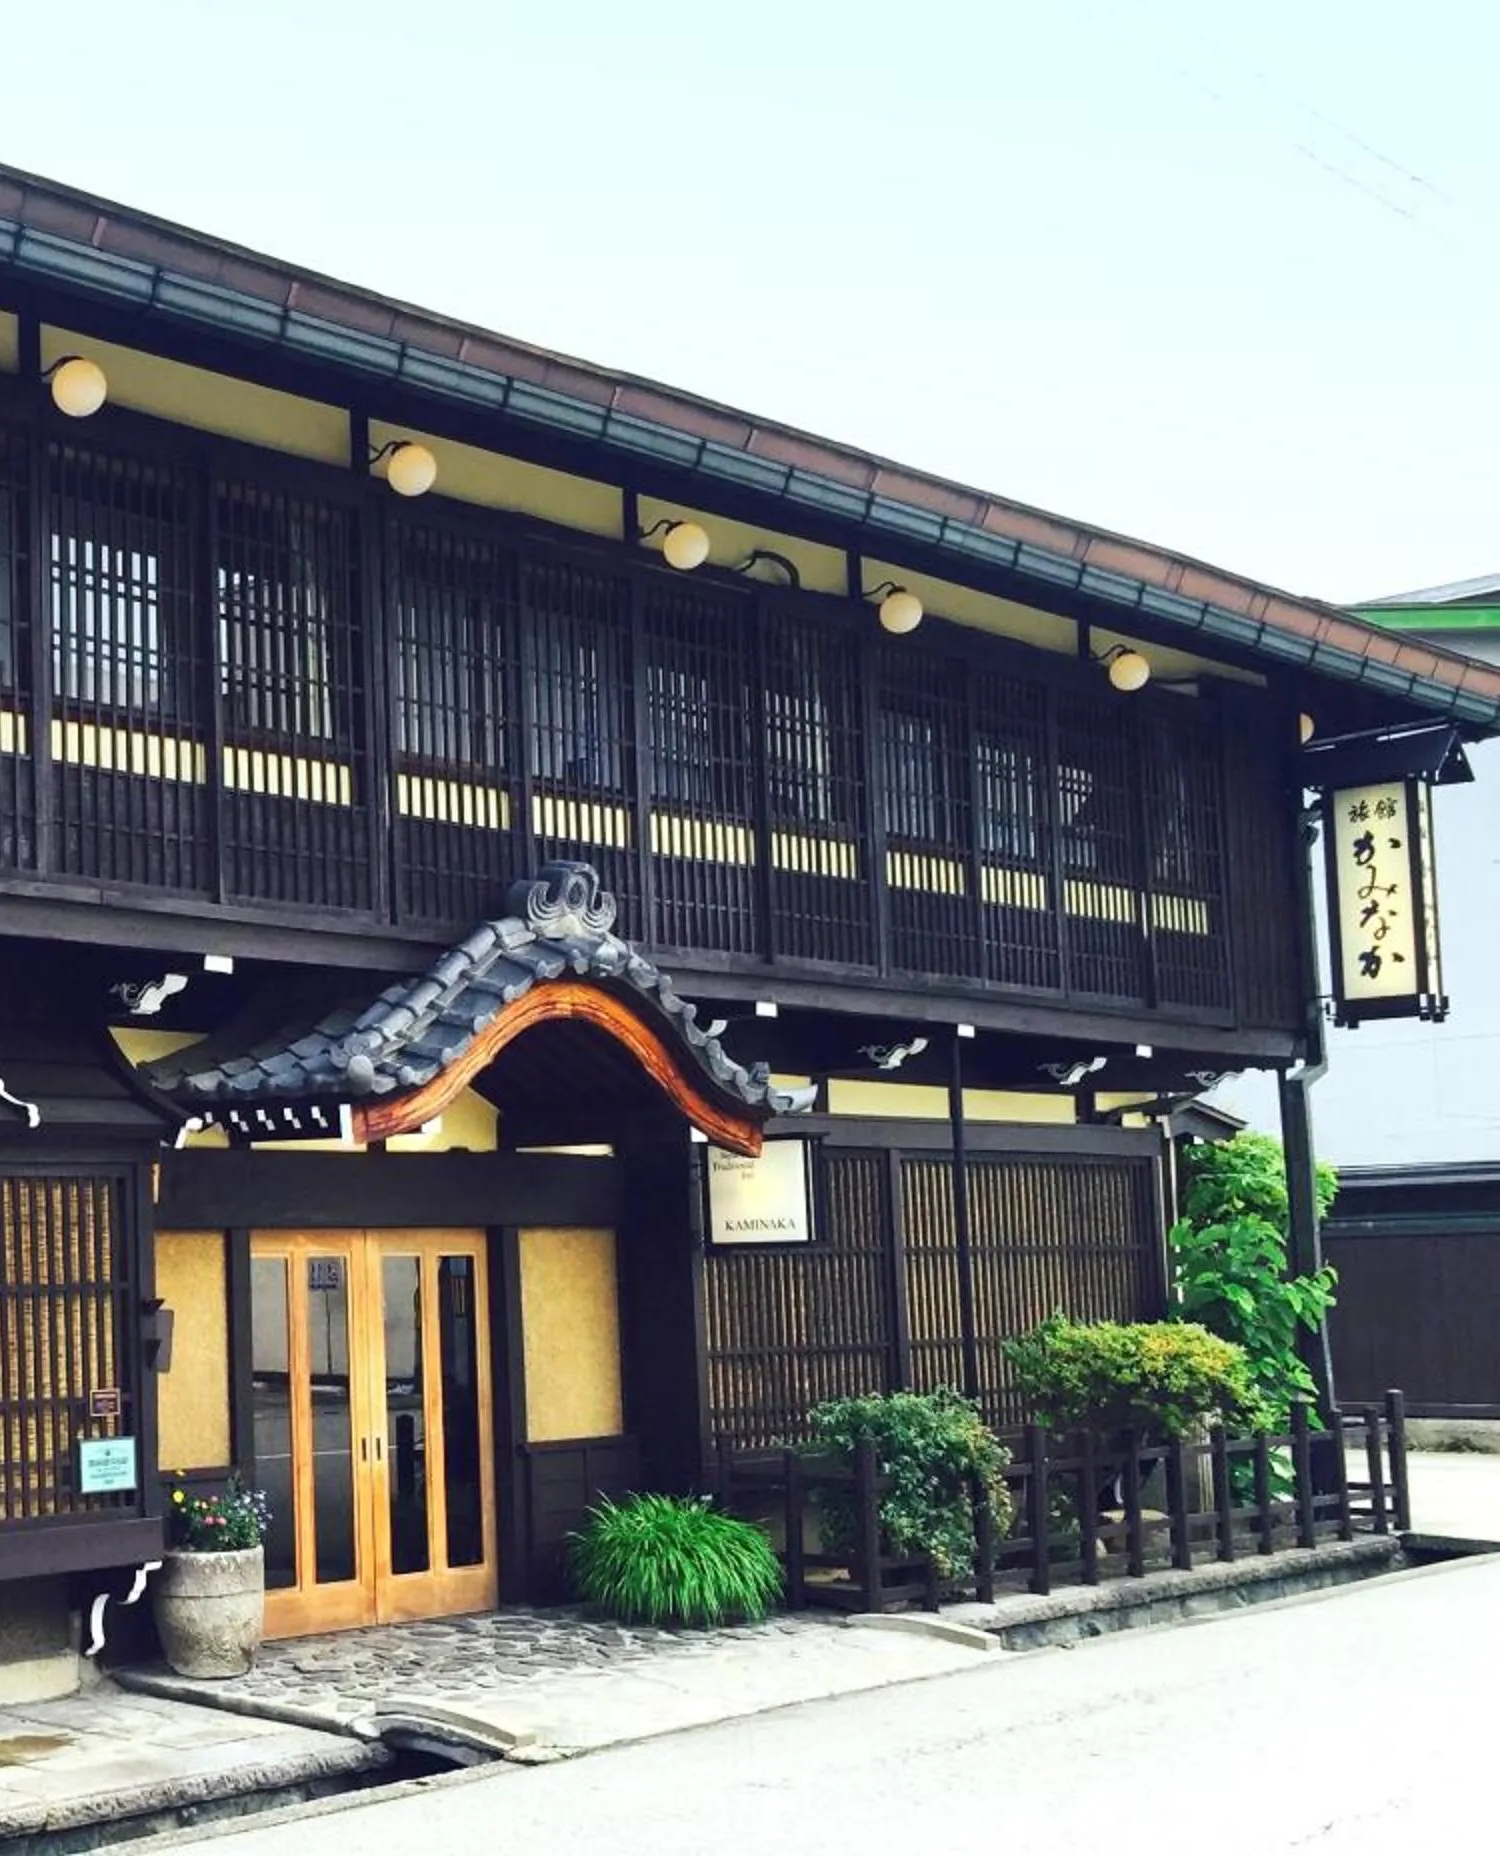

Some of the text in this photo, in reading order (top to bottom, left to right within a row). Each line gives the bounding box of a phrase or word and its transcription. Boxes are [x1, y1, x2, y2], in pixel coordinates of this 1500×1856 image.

[1348, 798, 1399, 823] 旅館
[1353, 830, 1405, 979] かみなか
[725, 1218, 796, 1231] KAMINAKA
